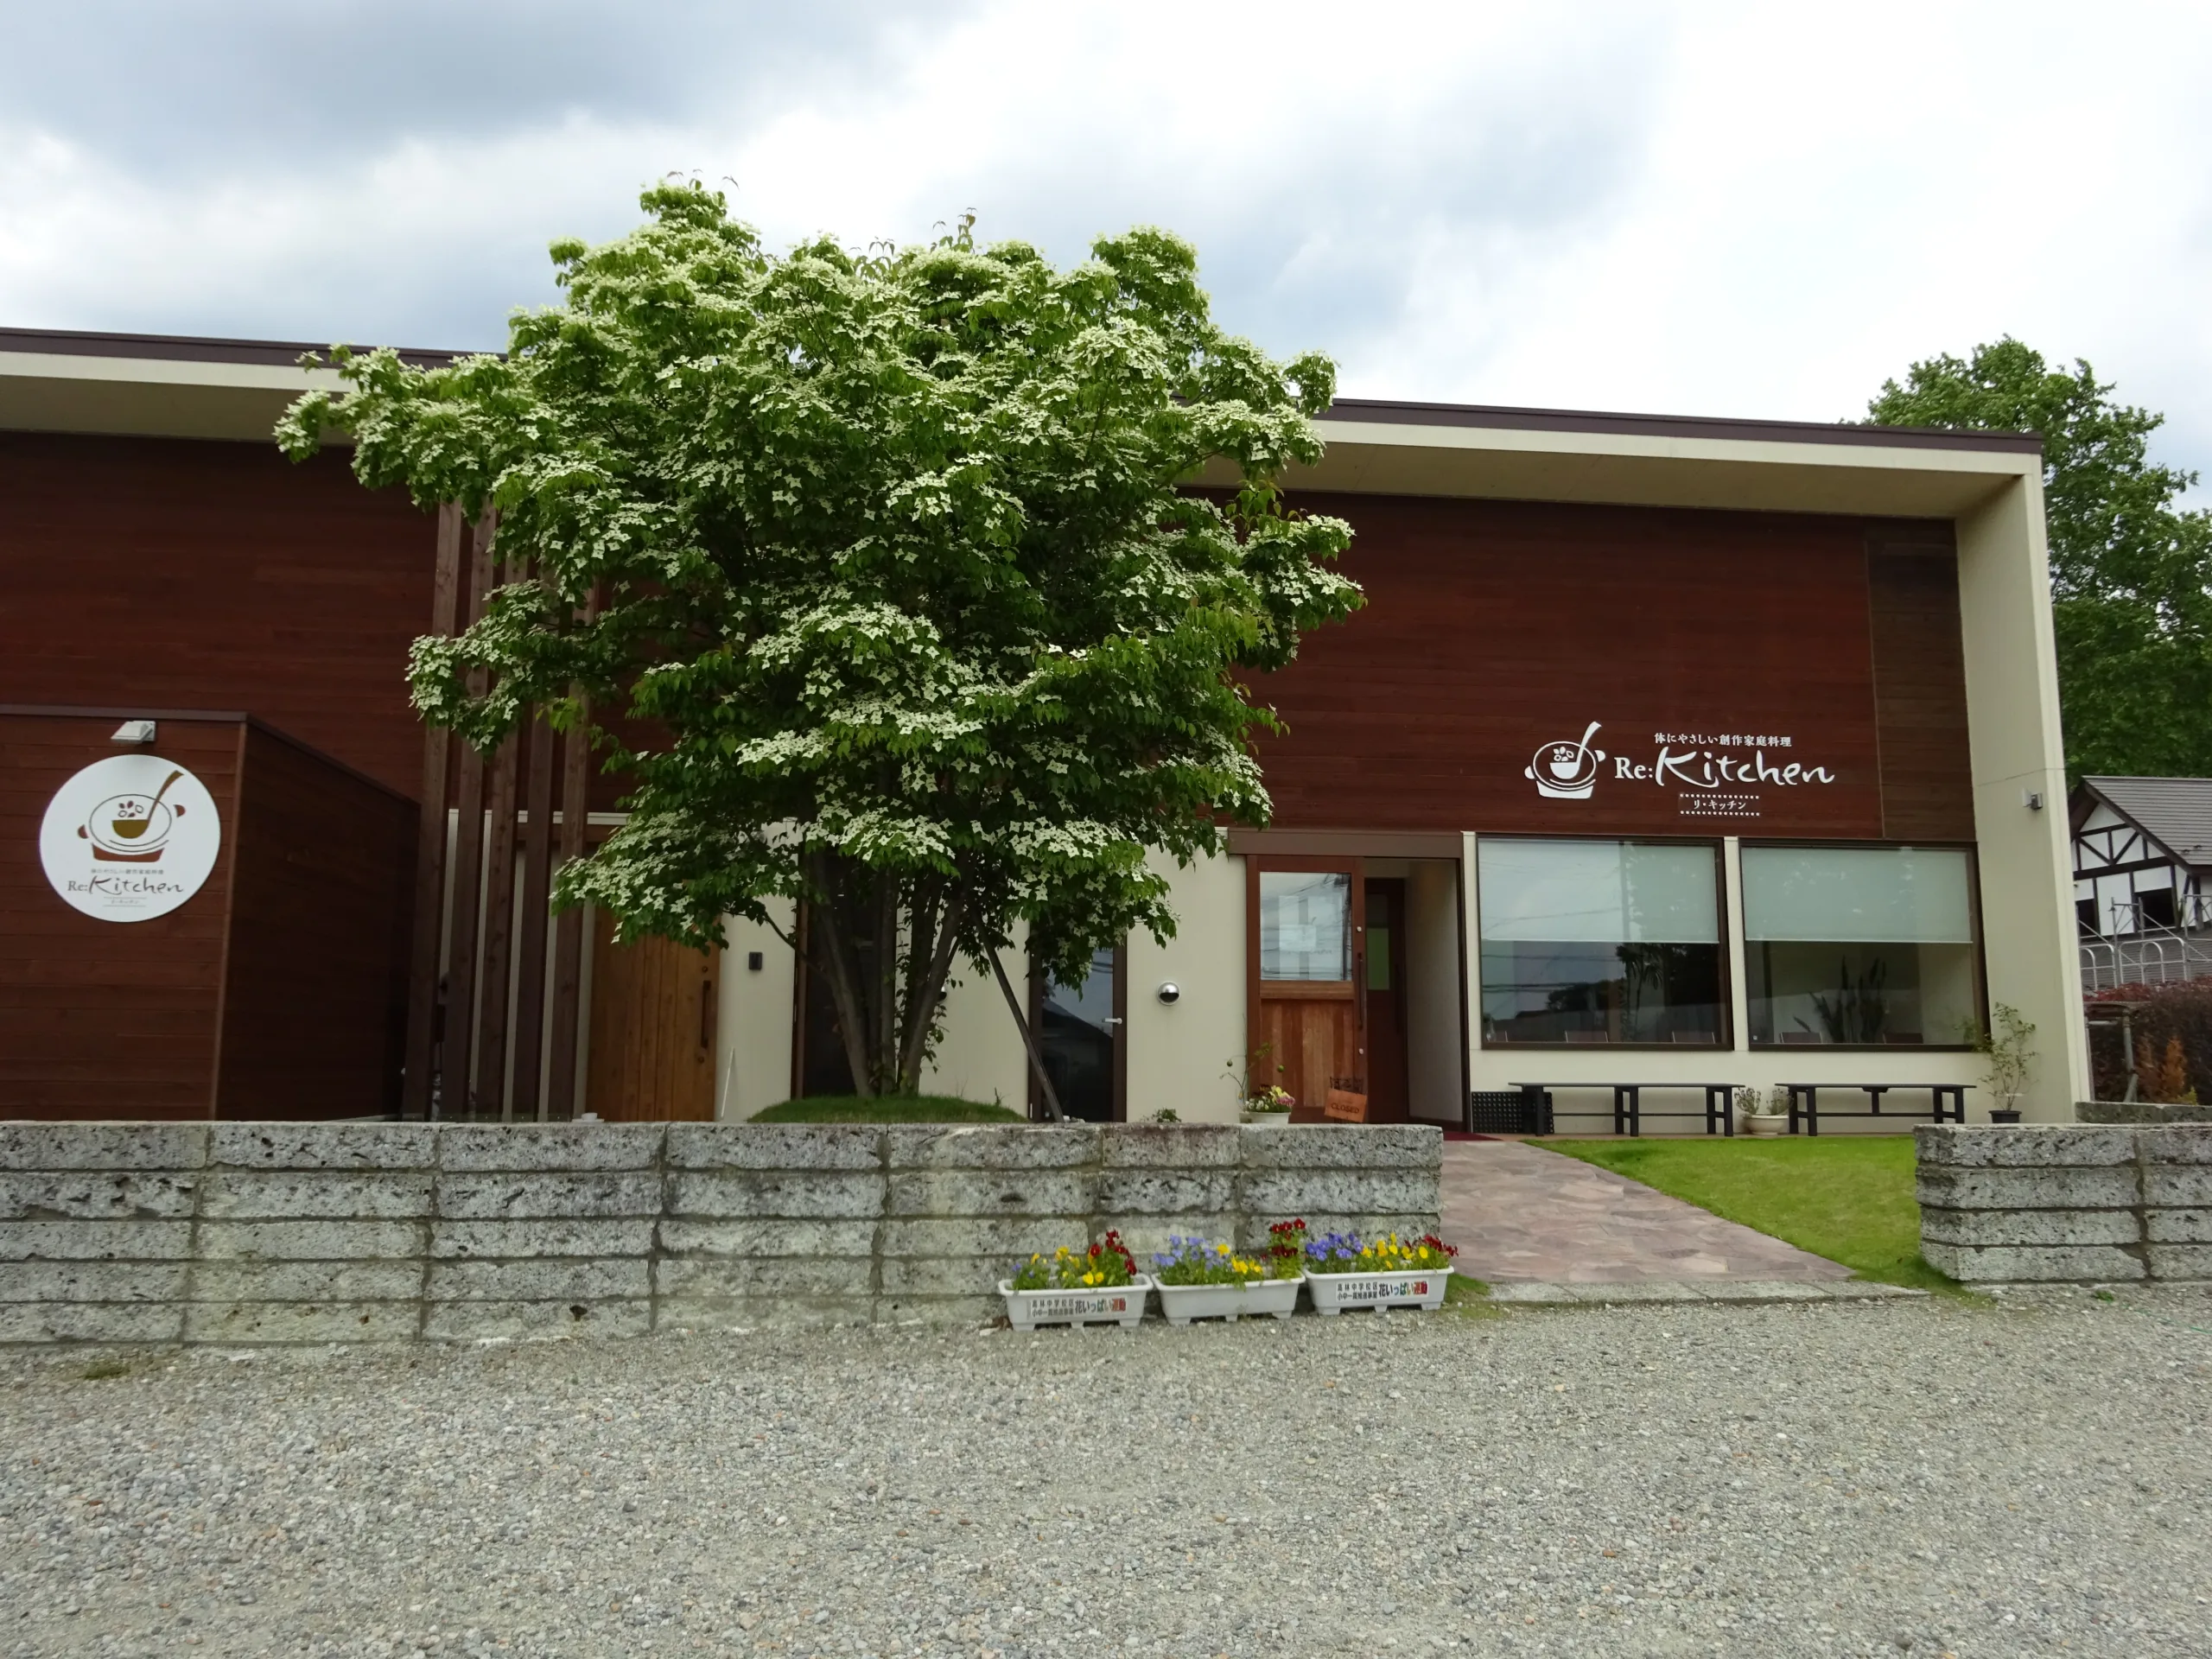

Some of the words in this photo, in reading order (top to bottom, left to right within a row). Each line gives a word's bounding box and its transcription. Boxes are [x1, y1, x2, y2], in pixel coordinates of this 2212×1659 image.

[1654, 733, 1792, 747] 体にやさしい創作家庭料理
[1613, 746, 1835, 788] Re:Kitchen
[1693, 799, 1746, 810] リ・キッチン
[67, 875, 184, 895] Re:Kitchen
[1330, 1102, 1360, 1115] CLOSED
[1379, 1281, 1427, 1298] 花いっぱい運動
